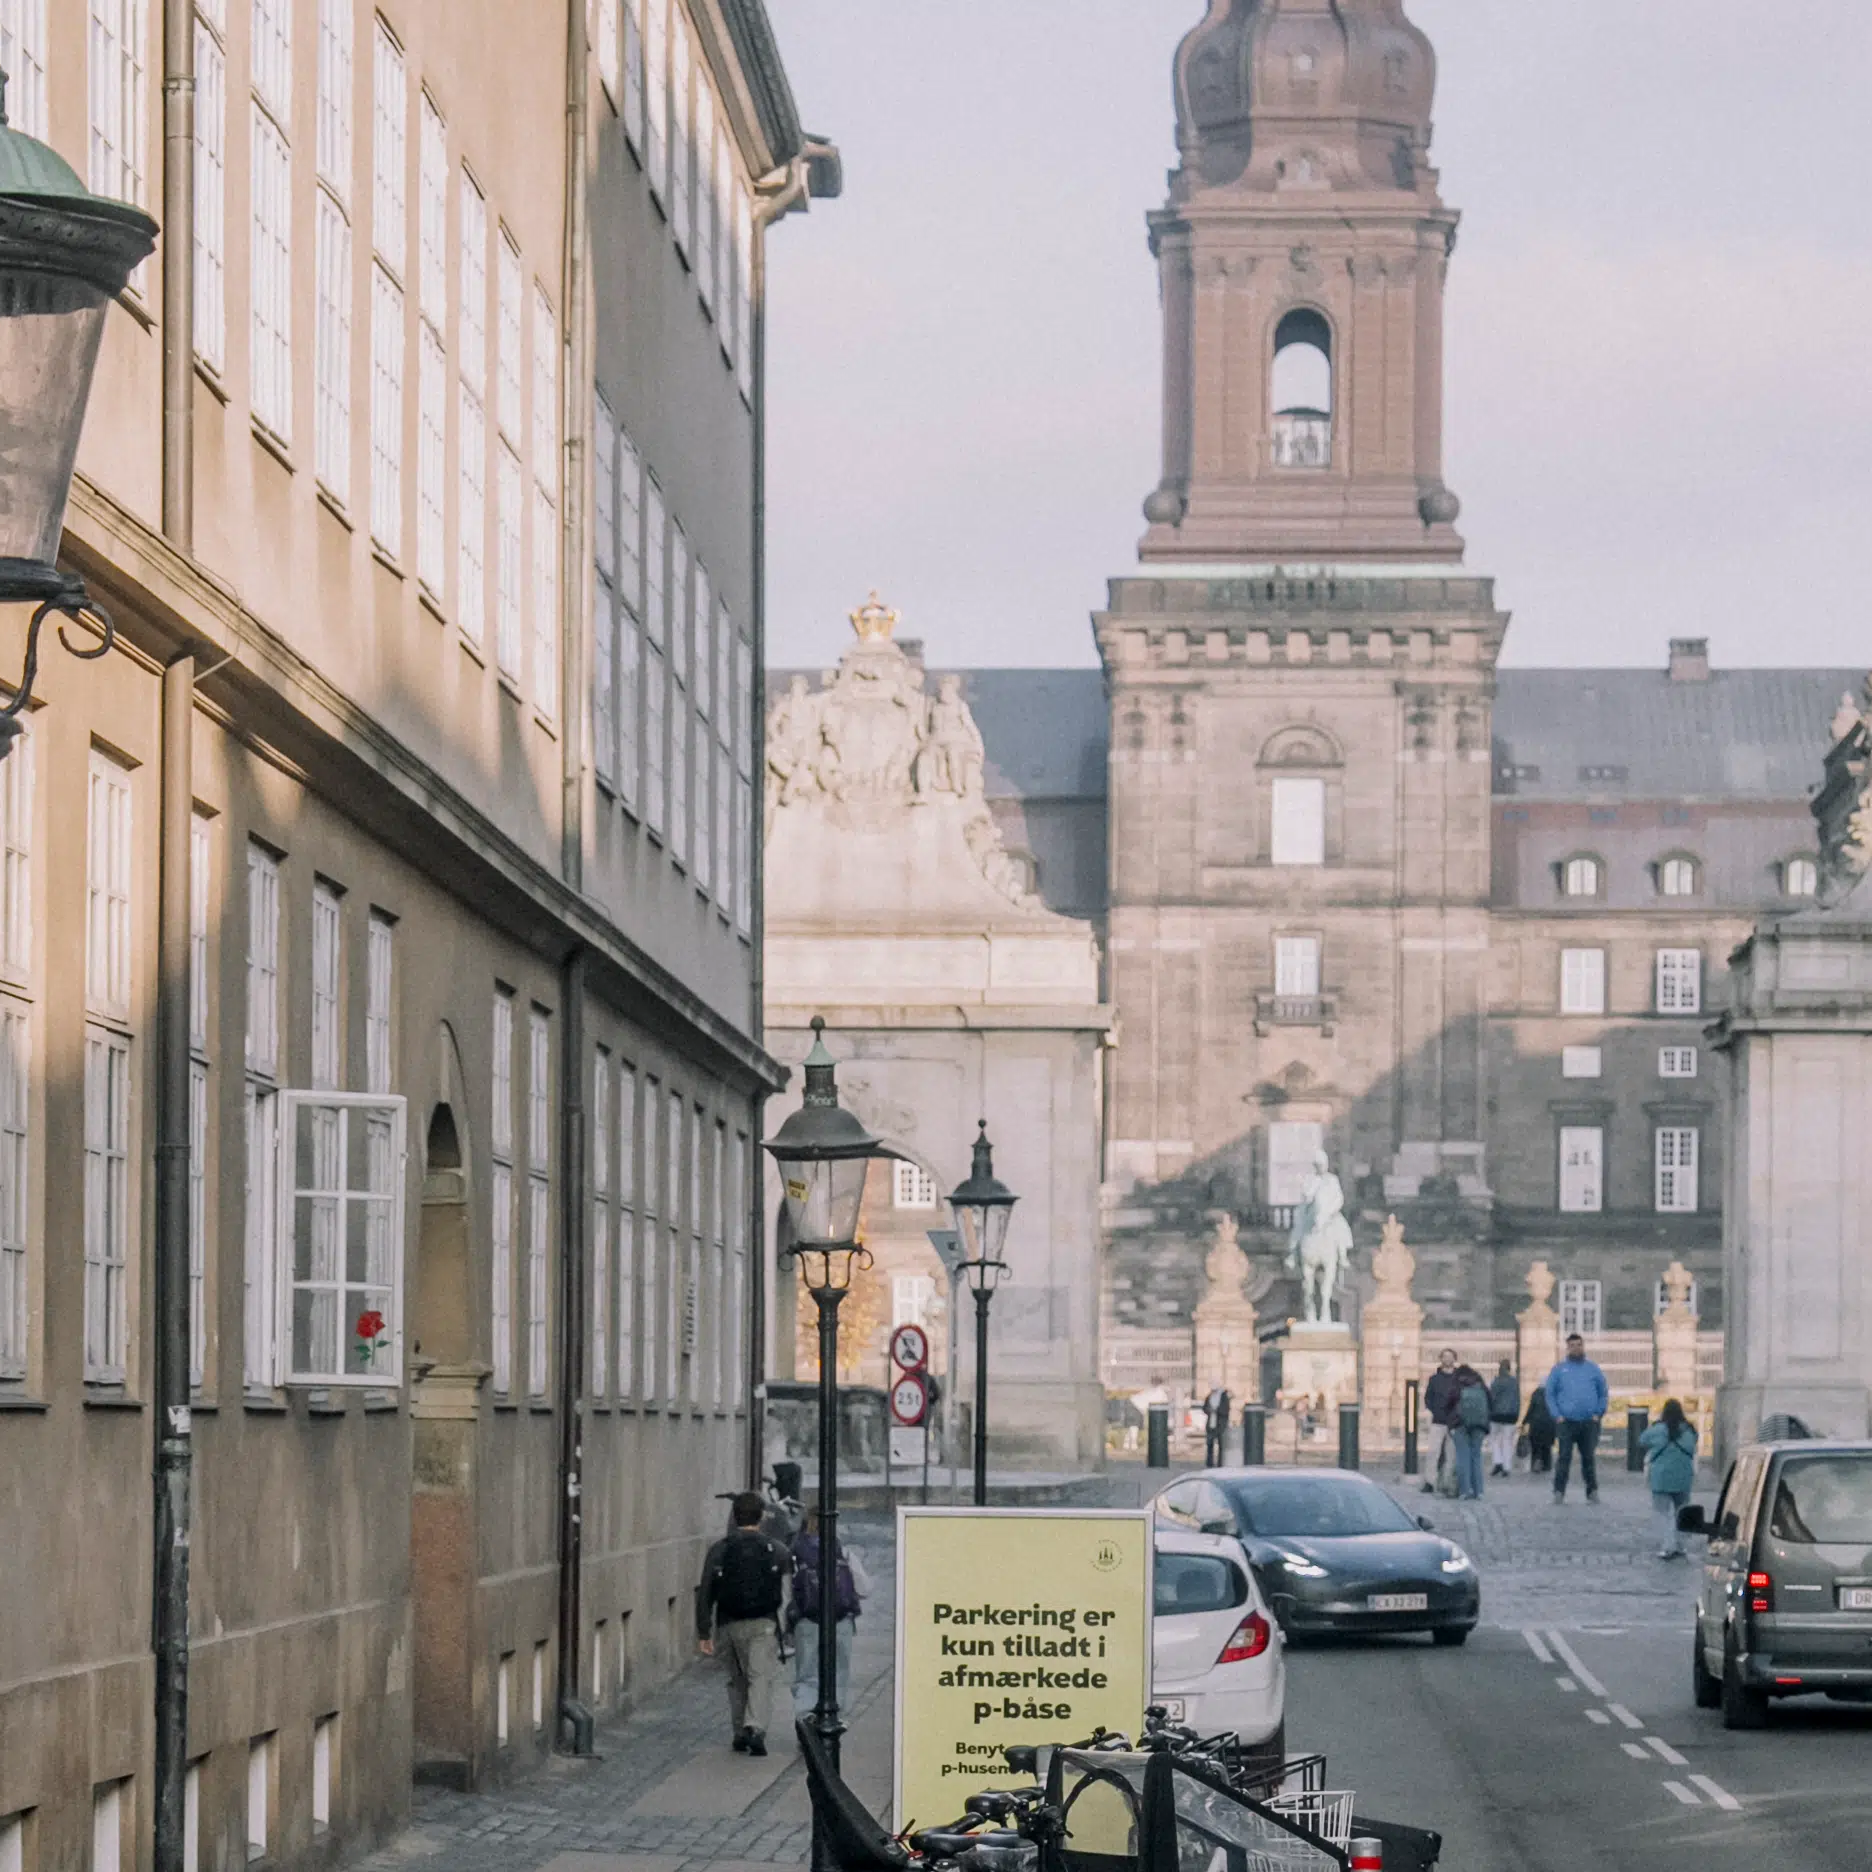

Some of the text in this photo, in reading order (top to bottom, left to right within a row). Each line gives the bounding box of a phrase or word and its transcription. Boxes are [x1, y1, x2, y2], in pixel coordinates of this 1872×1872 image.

[933, 1603, 1115, 1634] Parkering er
[941, 1634, 1106, 1657] kun tilladt i
[938, 1664, 1108, 1689] afmærkede
[974, 1696, 1072, 1724] p-båse
[955, 1742, 1005, 1758] Benyt
[941, 1761, 1017, 1777] p-husen
